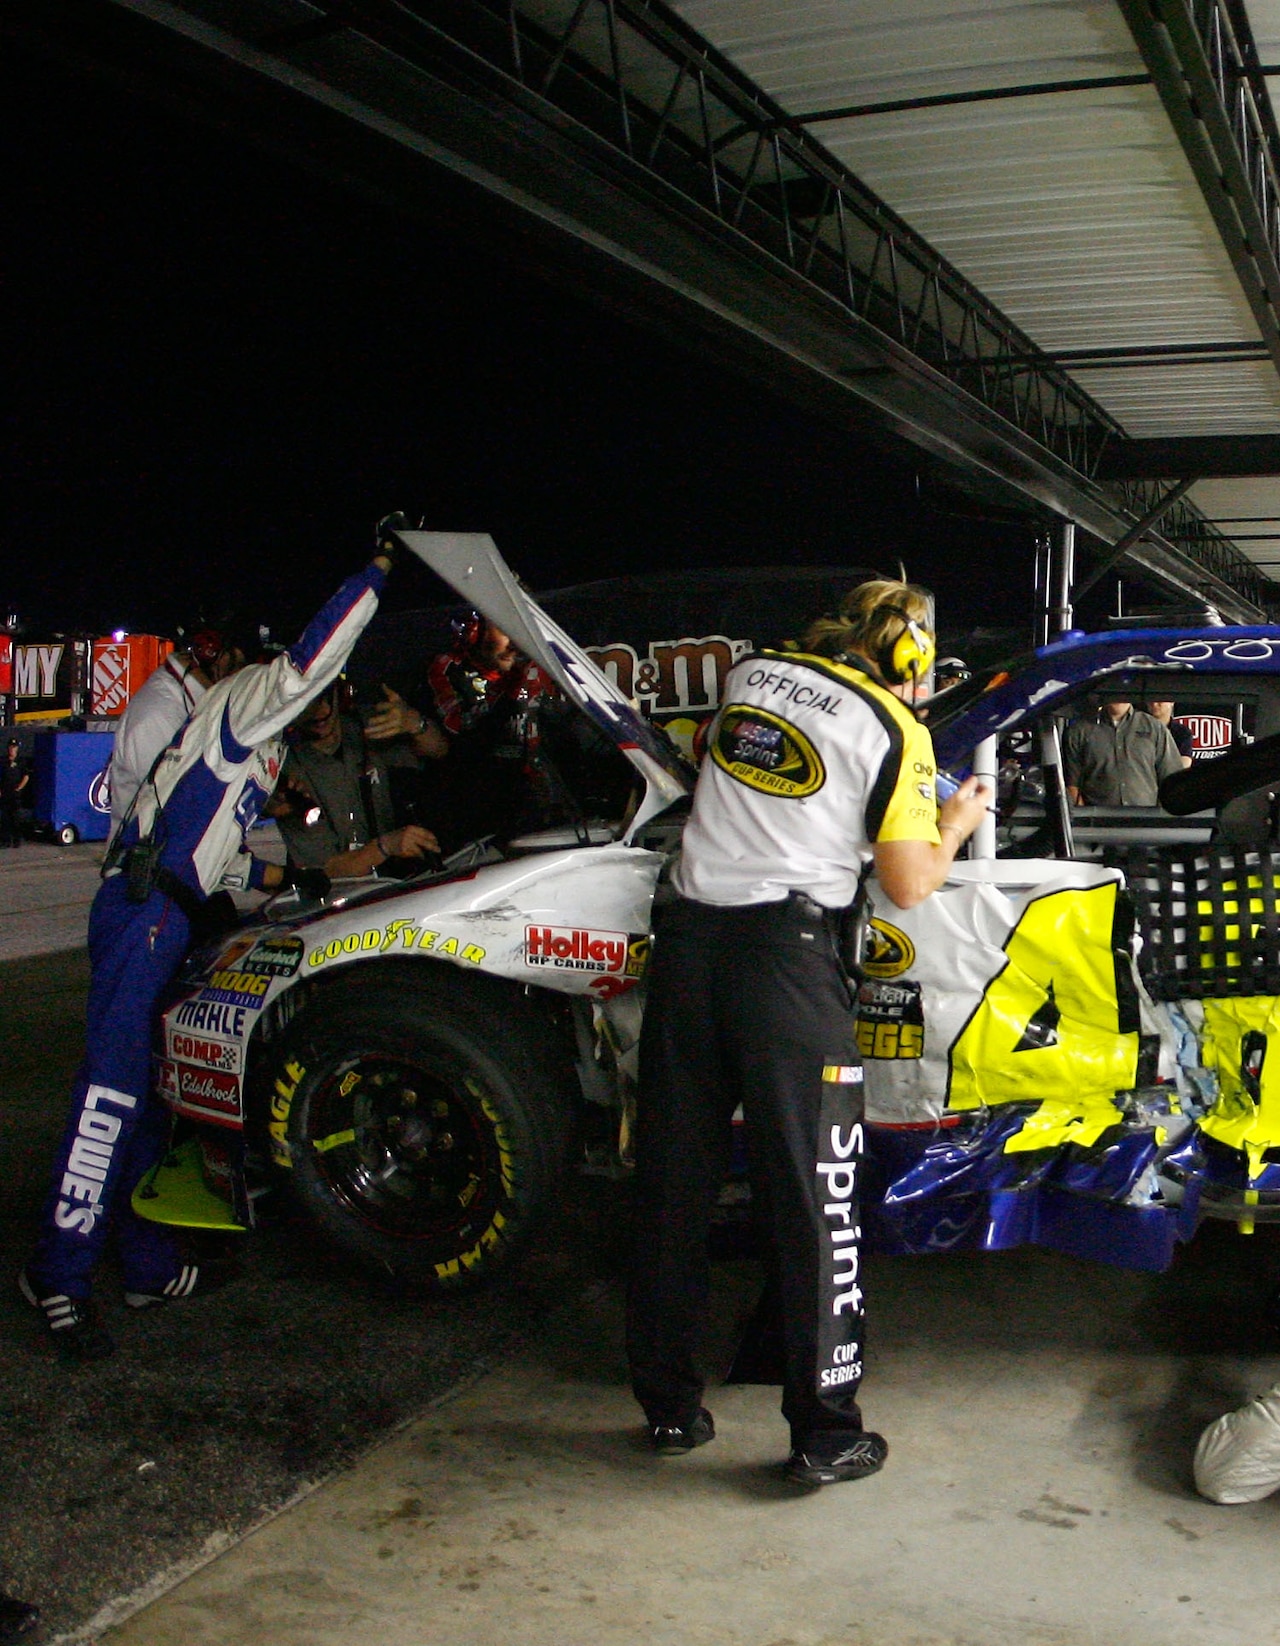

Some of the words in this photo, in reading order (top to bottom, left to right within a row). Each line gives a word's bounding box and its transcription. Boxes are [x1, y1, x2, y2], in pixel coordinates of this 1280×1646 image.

[747, 668, 843, 717] OFFICIAL
[733, 738, 780, 767] Sprint
[732, 763, 754, 776] CUP
[752, 771, 797, 793] SERIES
[528, 926, 625, 972] Holley
[528, 955, 553, 966] HP
[554, 957, 606, 971] CARBS
[210, 970, 273, 996] MOOG
[176, 1001, 247, 1037] MAHLE
[173, 1034, 222, 1062] COMP
[854, 1021, 924, 1059] EGS
[180, 1071, 238, 1105] Edelbrock
[54, 1083, 138, 1235] LOWE'S
[815, 1122, 865, 1317] Sprint
[832, 1342, 859, 1364] CUP
[820, 1360, 862, 1387] SERIES
